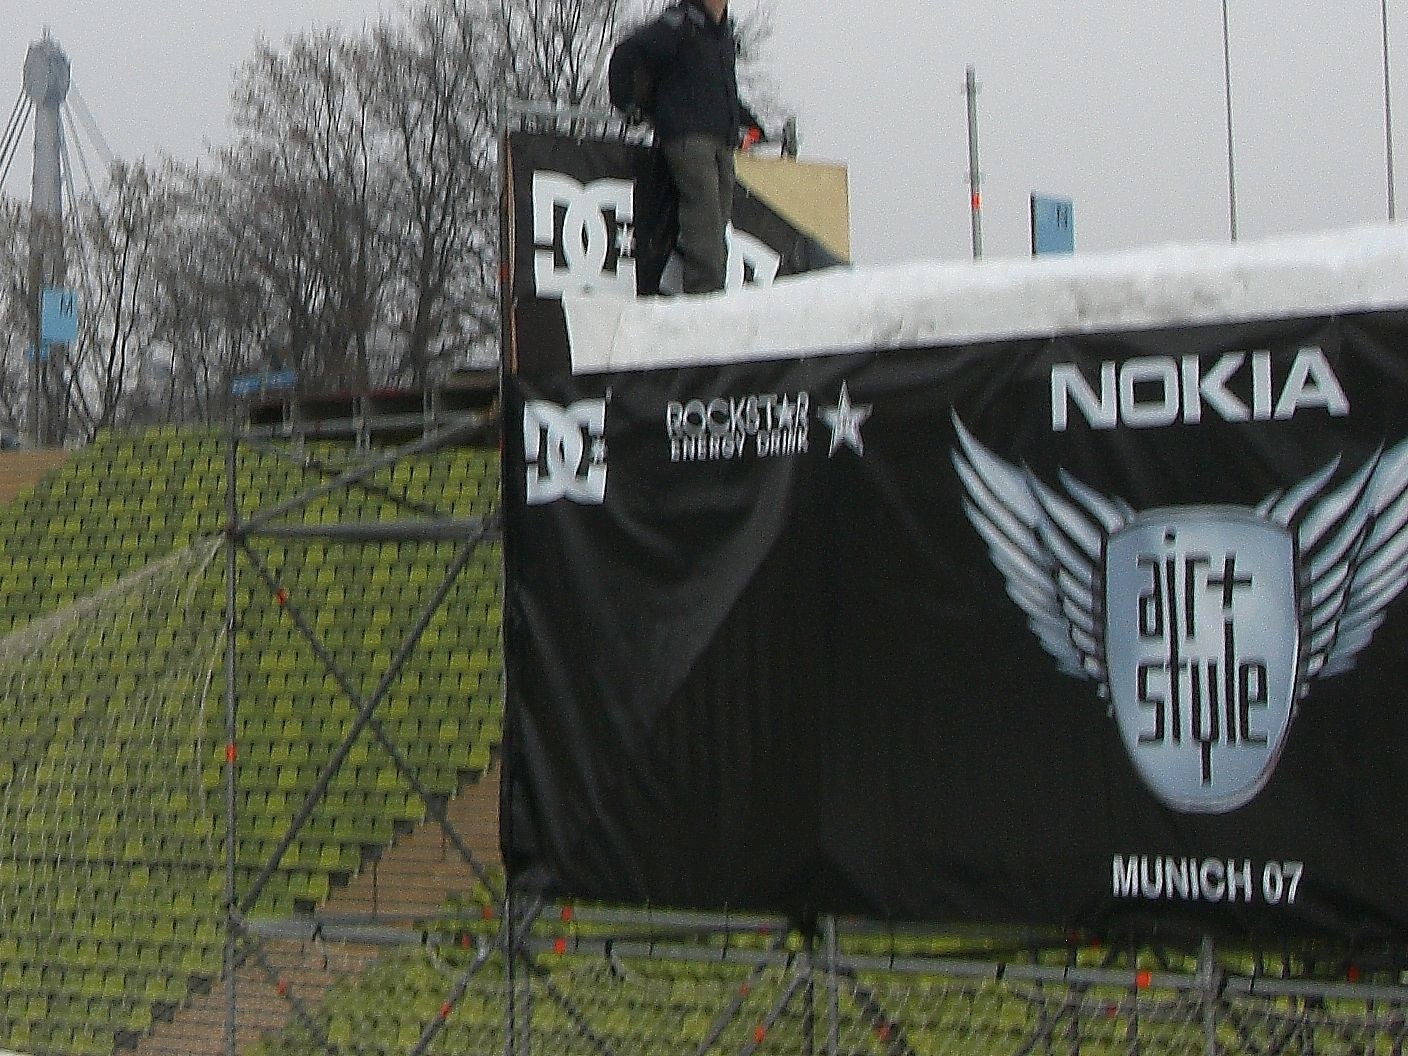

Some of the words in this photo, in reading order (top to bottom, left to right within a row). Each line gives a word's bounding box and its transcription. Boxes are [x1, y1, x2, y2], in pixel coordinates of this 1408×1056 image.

[1050, 347, 1351, 432] NOKIA
[1112, 854, 1253, 906] MUNICH
[1261, 861, 1303, 905] 07
